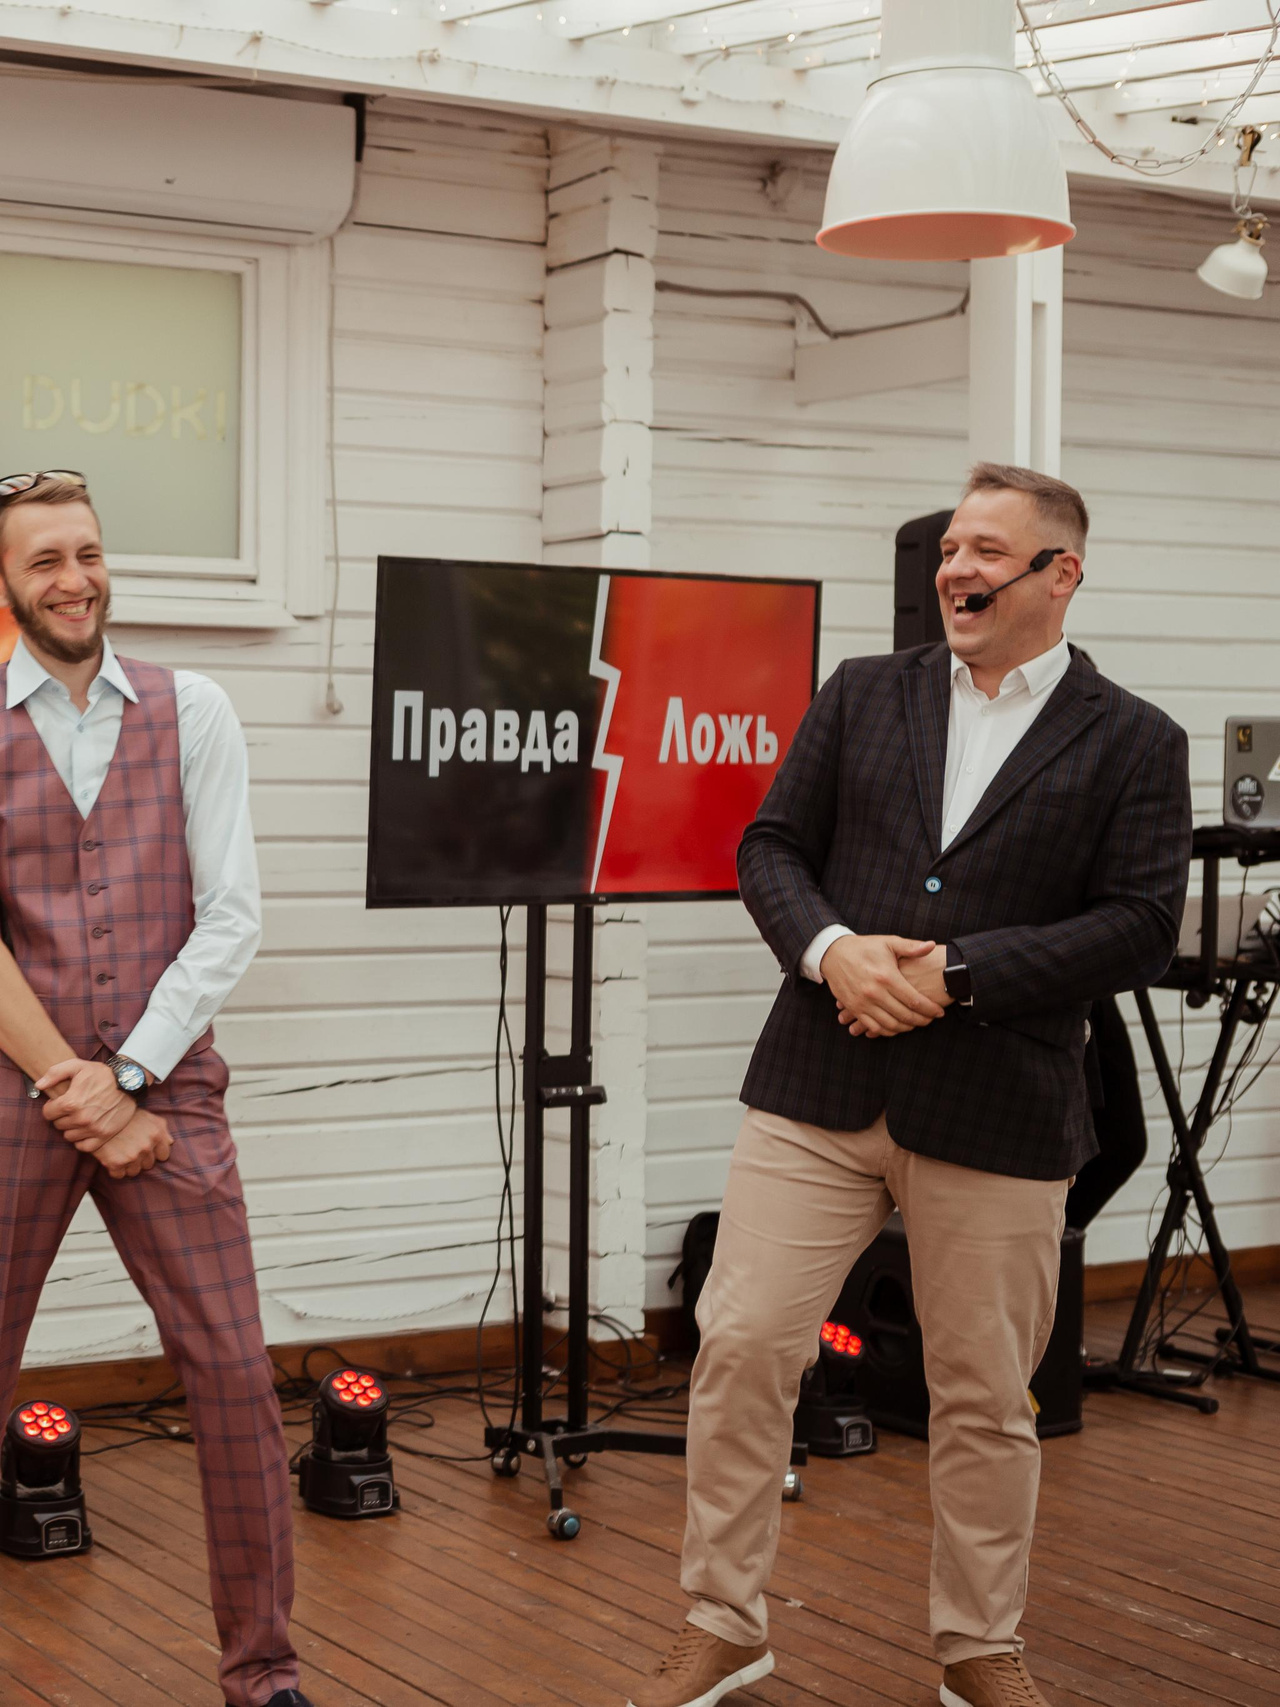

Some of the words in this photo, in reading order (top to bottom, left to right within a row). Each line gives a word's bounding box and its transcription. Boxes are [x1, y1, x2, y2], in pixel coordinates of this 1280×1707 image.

[22, 374, 227, 442] DUDKI
[392, 690, 579, 777] Правда
[658, 697, 779, 765] Ложь
